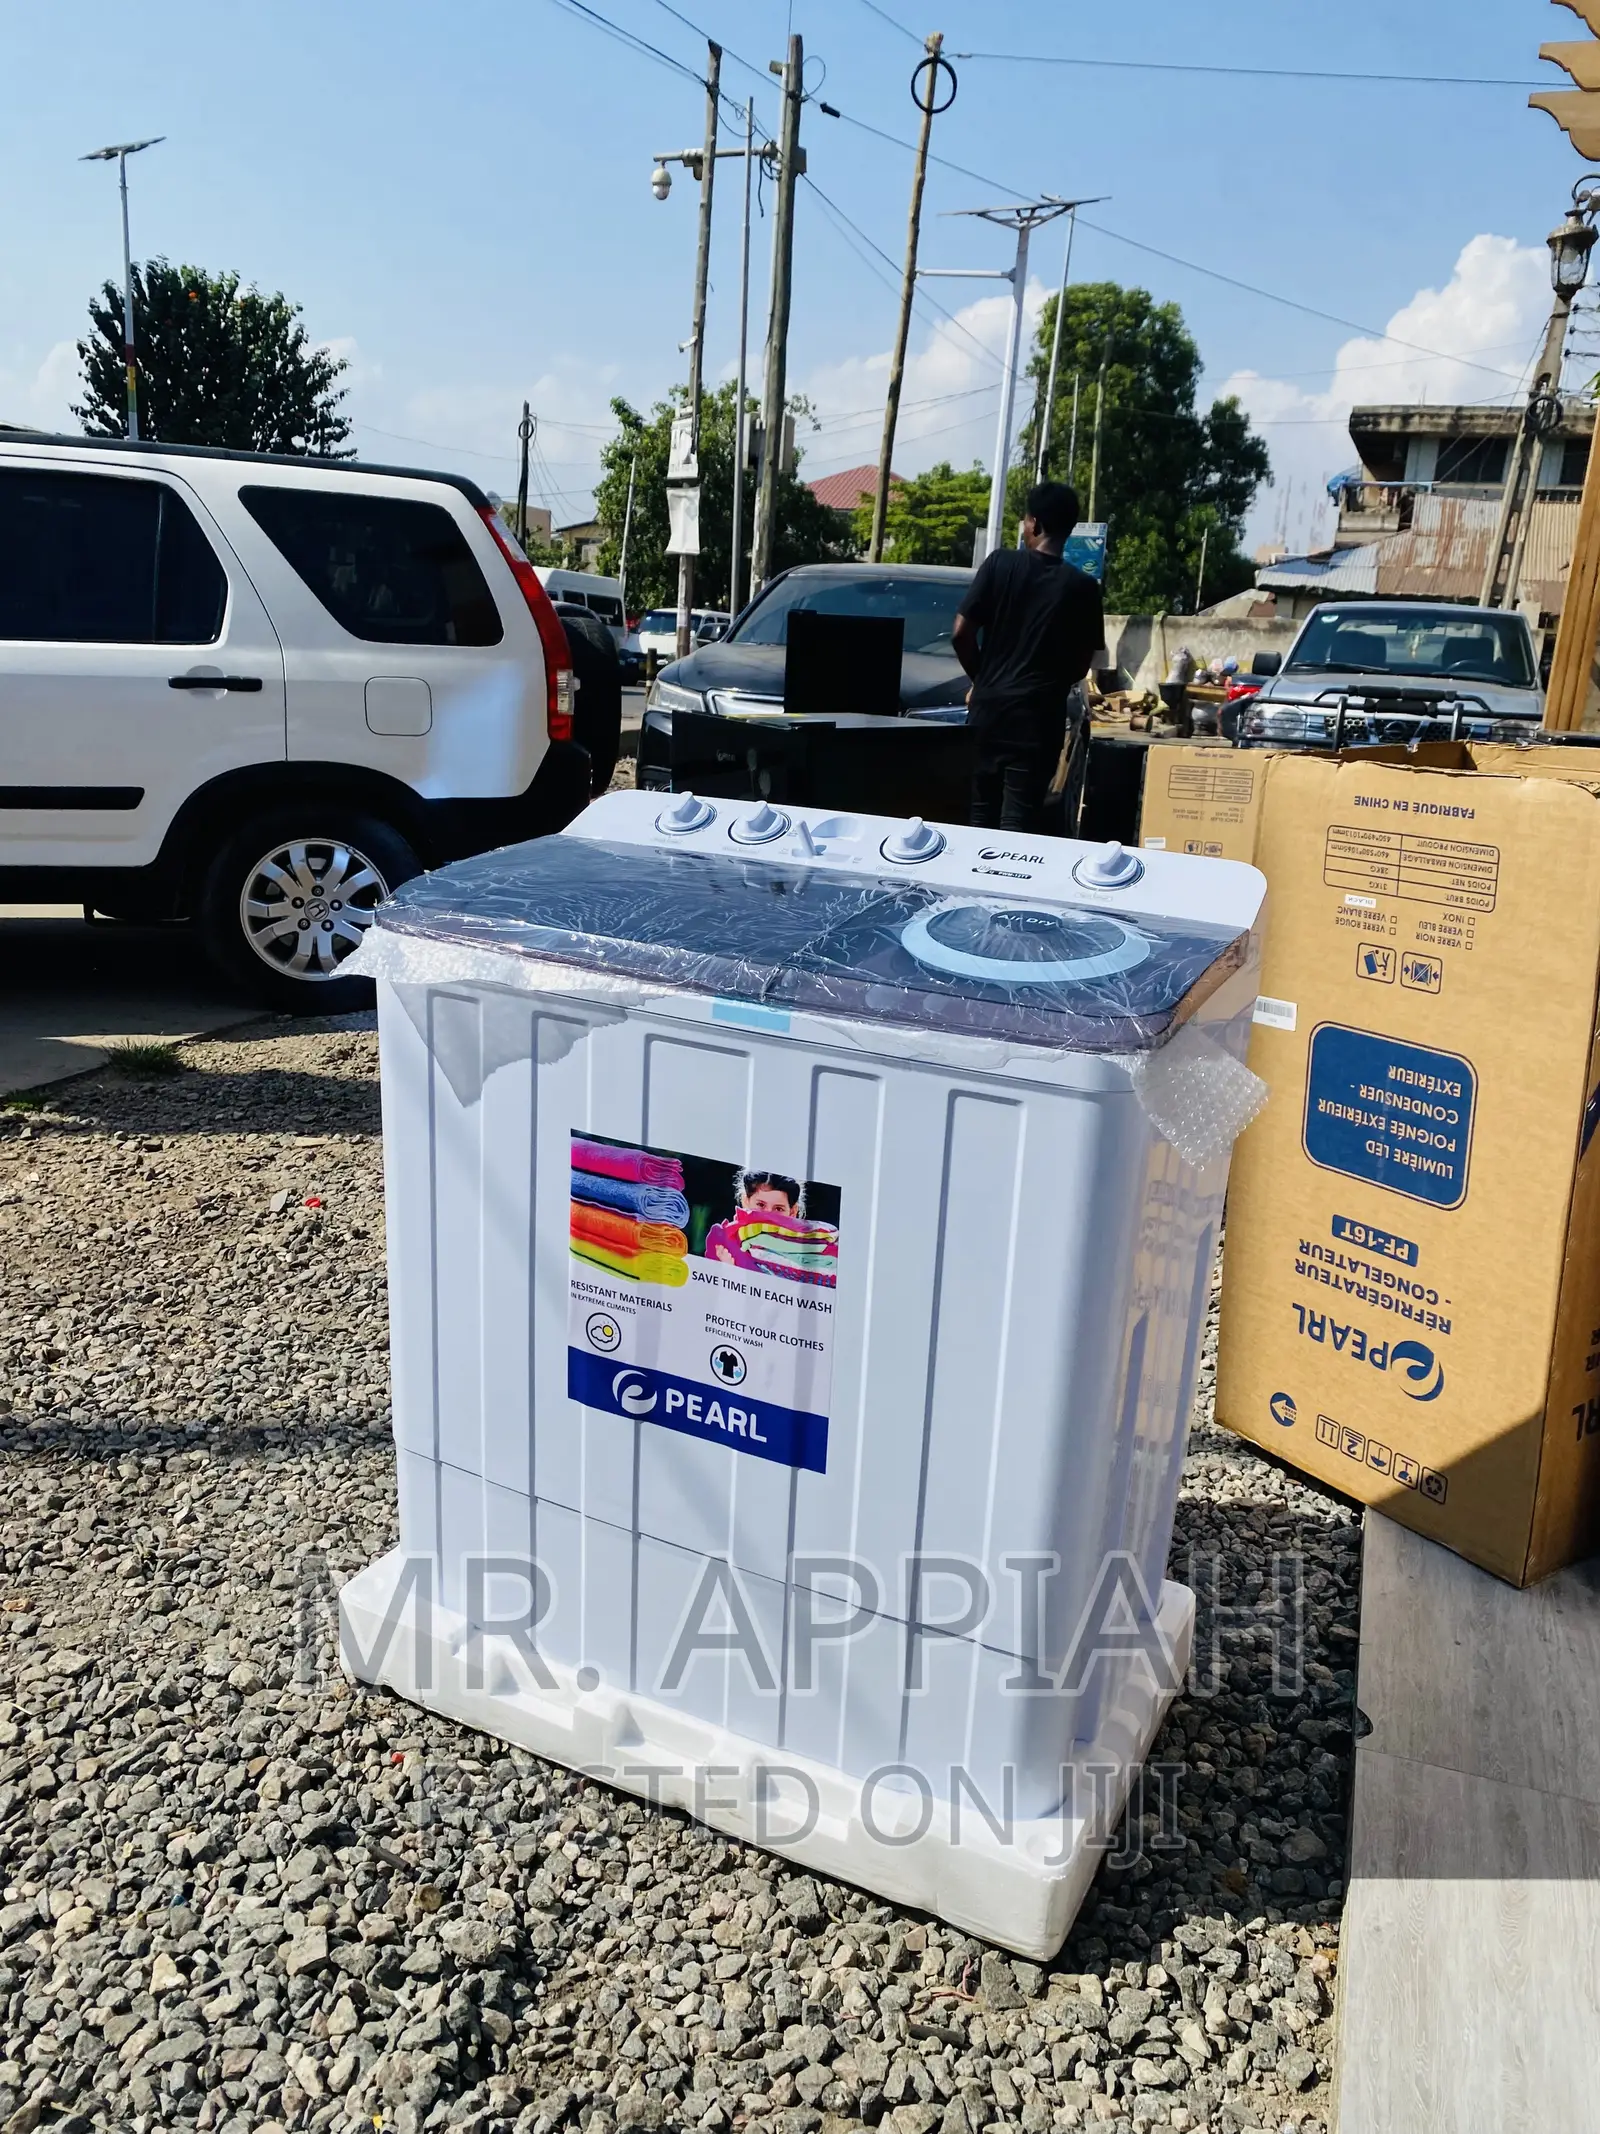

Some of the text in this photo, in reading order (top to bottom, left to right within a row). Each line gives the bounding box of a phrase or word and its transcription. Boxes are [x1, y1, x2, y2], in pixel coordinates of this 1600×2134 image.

[1353, 795, 1475, 819] FABRIQUÉ EN CHINE
[1000, 851, 1046, 865] PEARL
[1450, 845, 1495, 857] DIMENSION
[1448, 860, 1493, 874] DIMENSION
[1368, 881, 1388, 891] 31KG
[1467, 880, 1492, 891] POIDS
[1465, 896, 1490, 908] POIDS
[1026, 917, 1056, 926] Dry
[1335, 916, 1386, 933] VERRE ROUGE
[1336, 905, 1387, 922] VERRE BLANC
[1442, 912, 1465, 924] INOX
[1418, 920, 1463, 936] VERRE BLEU
[1415, 931, 1462, 948] VERRE NOIR
[1387, 1065, 1462, 1098] EXTÉRIEUR
[1359, 1083, 1459, 1125] CONDENSUER
[1318, 1098, 1456, 1152] POIGNÉE EXTÉRIEUR
[1365, 1139, 1453, 1179] LUMIÈRE LED
[1340, 1222, 1409, 1261] PF-16T
[1298, 1238, 1439, 1306] CONGELATEUR
[570, 1280, 673, 1312] RESISTANT MATERIALS
[692, 1271, 832, 1314] SAVE TIME IN EACH WASH
[1295, 1258, 1452, 1335] RÉFRIGÉRATEUR
[578, 1293, 605, 1307] EXTREME
[606, 1300, 636, 1315] CLIMATES
[705, 1313, 824, 1351] PROTECT YOUR CLOTHES
[705, 1326, 763, 1348] EFFICIENTLY WASH
[1292, 1302, 1389, 1371] PEARL
[665, 1387, 767, 1443] PEARL
